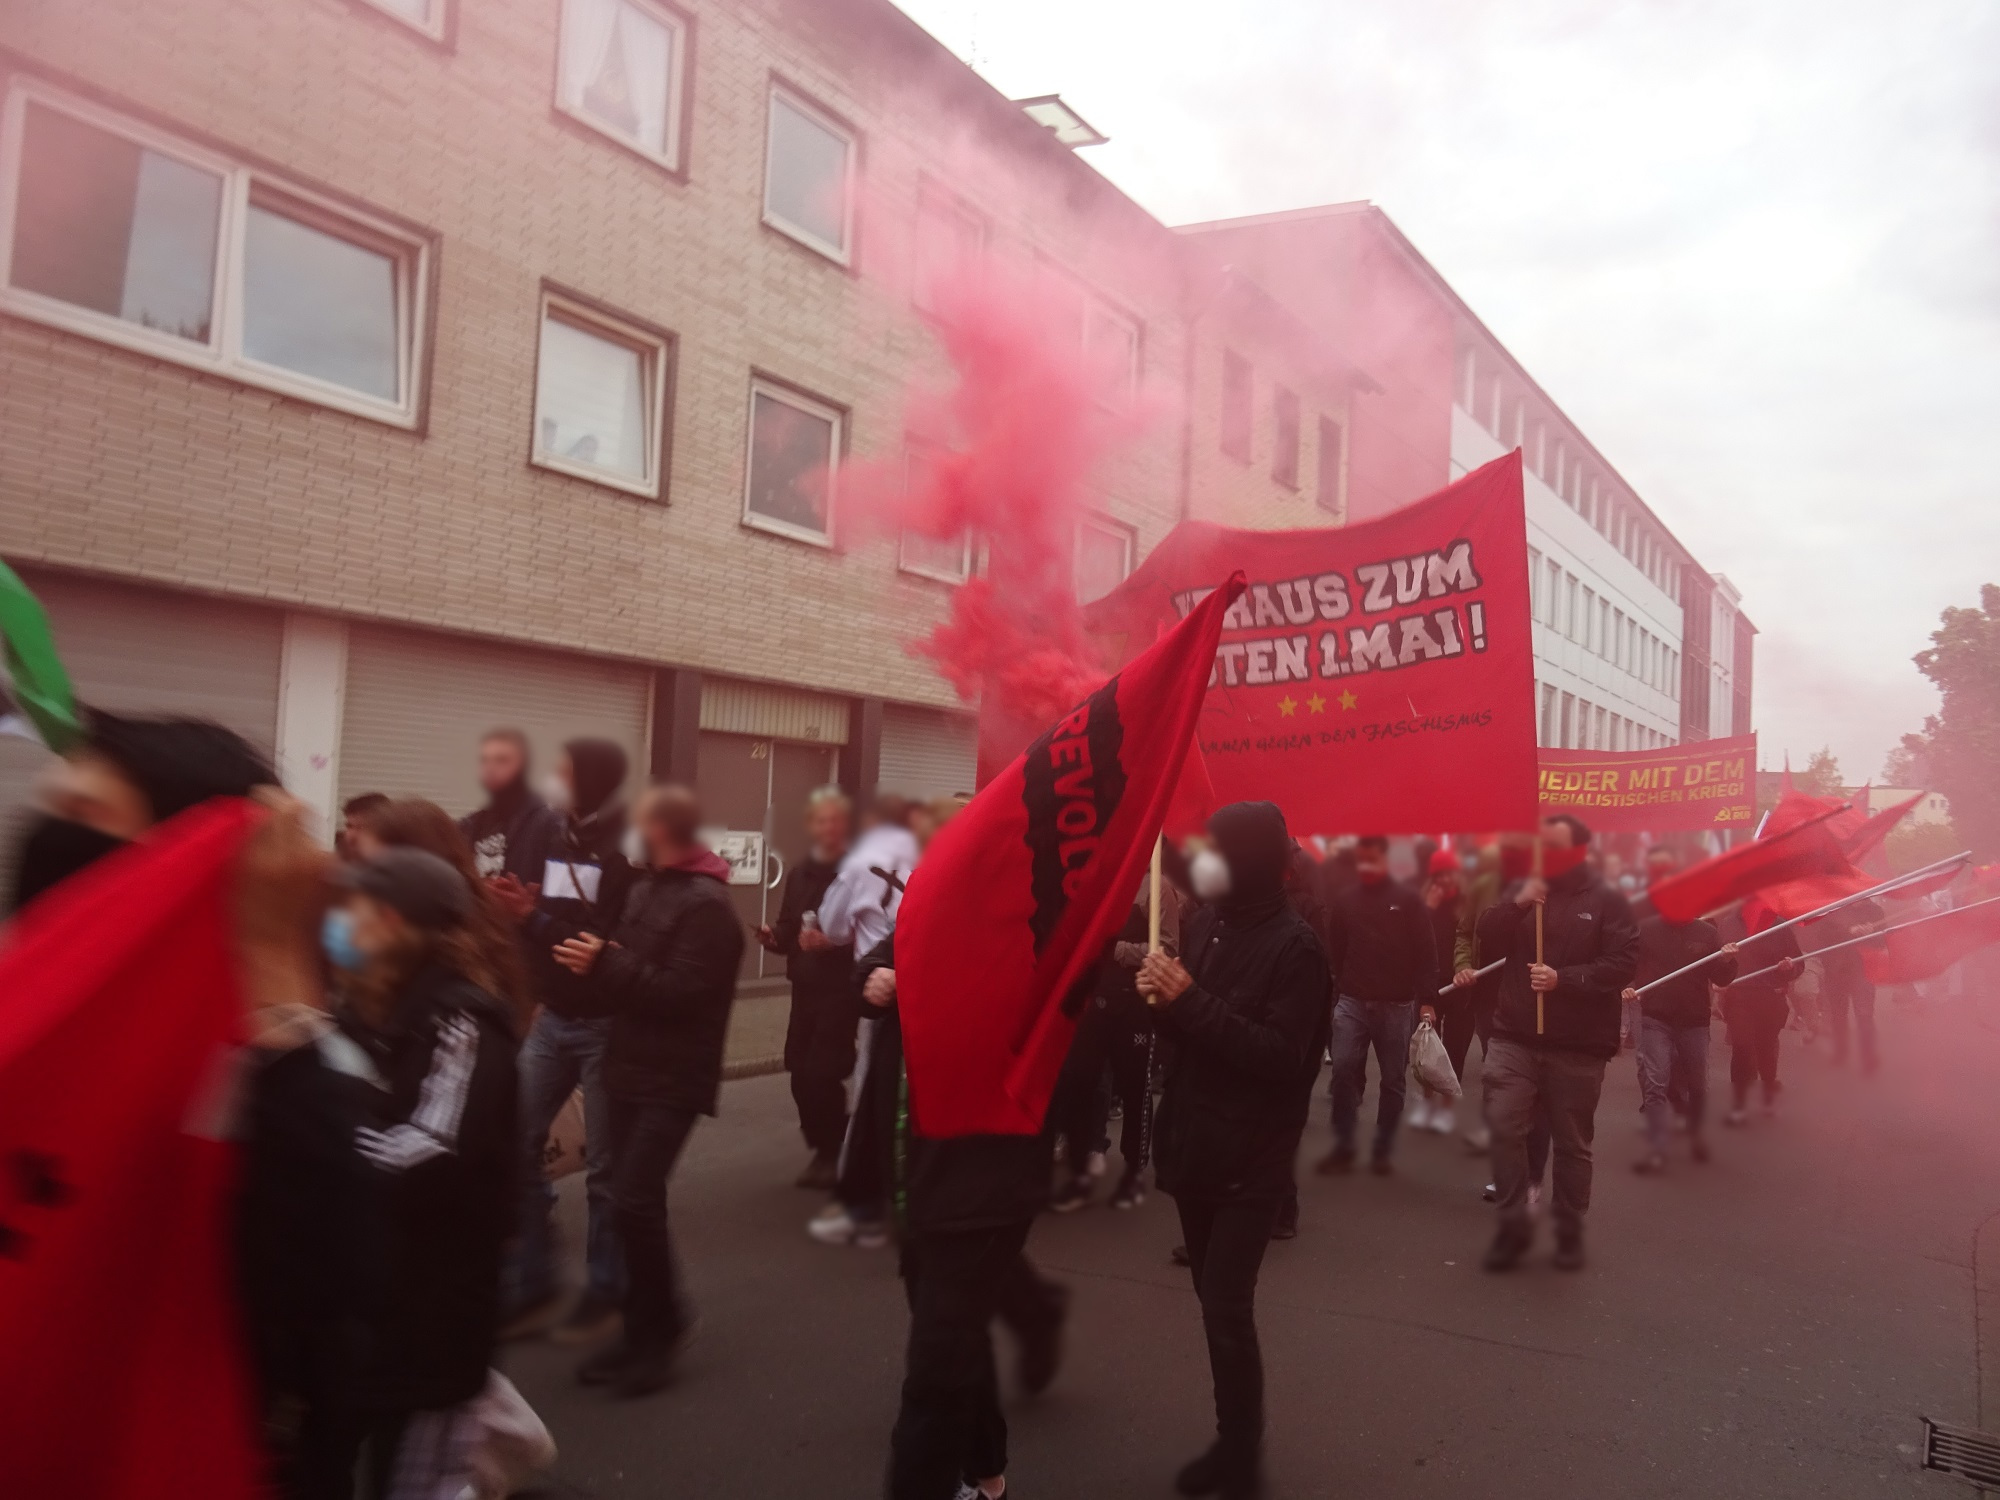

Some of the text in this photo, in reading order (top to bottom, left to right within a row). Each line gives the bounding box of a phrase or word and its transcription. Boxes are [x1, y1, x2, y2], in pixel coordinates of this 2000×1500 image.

[1173, 541, 1481, 630] RAUS ZUM
[1208, 636, 1308, 687] TEN
[1320, 729, 1356, 745] DEN
[1364, 711, 1491, 741] FASCHISMUS
[1629, 766, 1677, 790] MIT
[1684, 758, 1744, 786] DEM
[1689, 783, 1744, 800] KRIEG!
